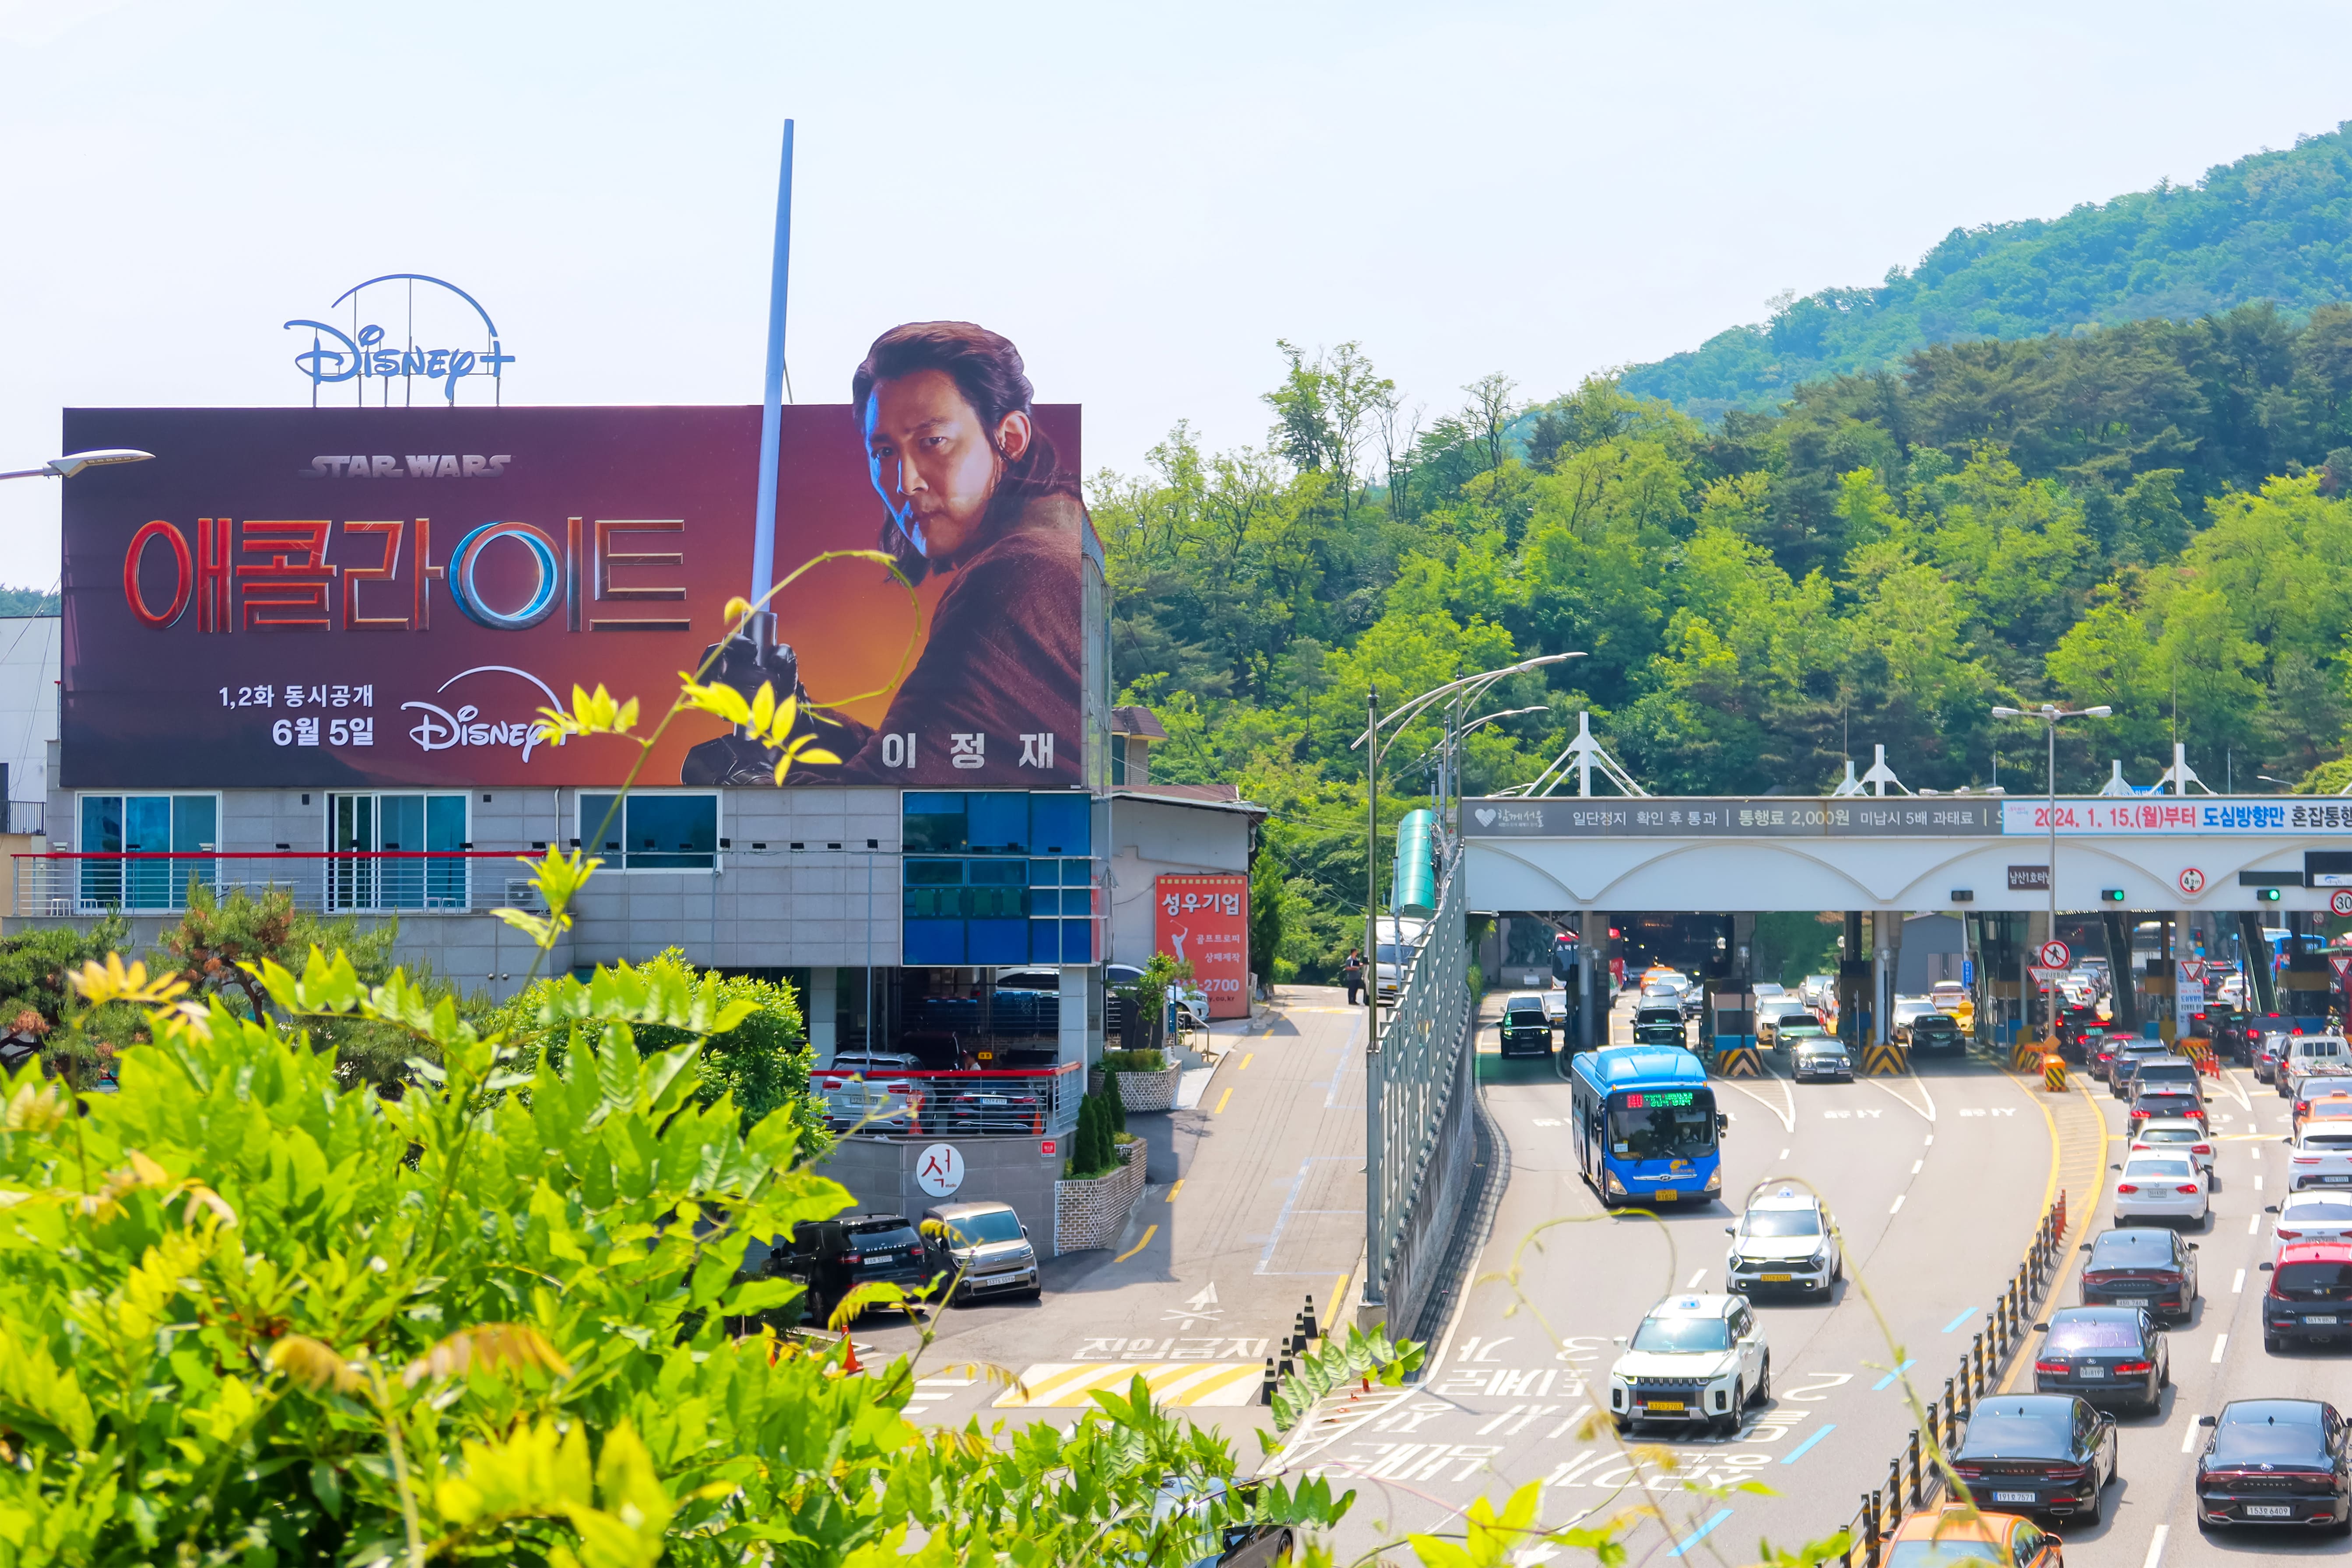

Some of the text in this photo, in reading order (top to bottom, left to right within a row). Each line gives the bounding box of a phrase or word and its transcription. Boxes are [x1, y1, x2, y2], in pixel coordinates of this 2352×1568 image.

[298, 455, 511, 478] STAR WARS
[124, 517, 691, 632] 애콜라이트
[218, 684, 373, 709] 1,2화 동시공개
[272, 717, 374, 747] 6월 5일
[1573, 809, 1974, 827] 일단정지 확인 후 통과 통행료 2,000원 미납시 5배 과태료
[2088, 808, 2102, 827] 1.
[2203, 806, 2285, 828] 도심방향만
[1162, 893, 1240, 916] 성우기업
[2336, 896, 2352, 909] 30
[1196, 934, 1240, 945] 골프트로피
[1205, 952, 1240, 963] 상패제작
[866, 1244, 906, 1252] DISCOVERY
[1071, 1337, 1270, 1360] 진입금지
[2018, 1493, 2033, 1502] 7571
